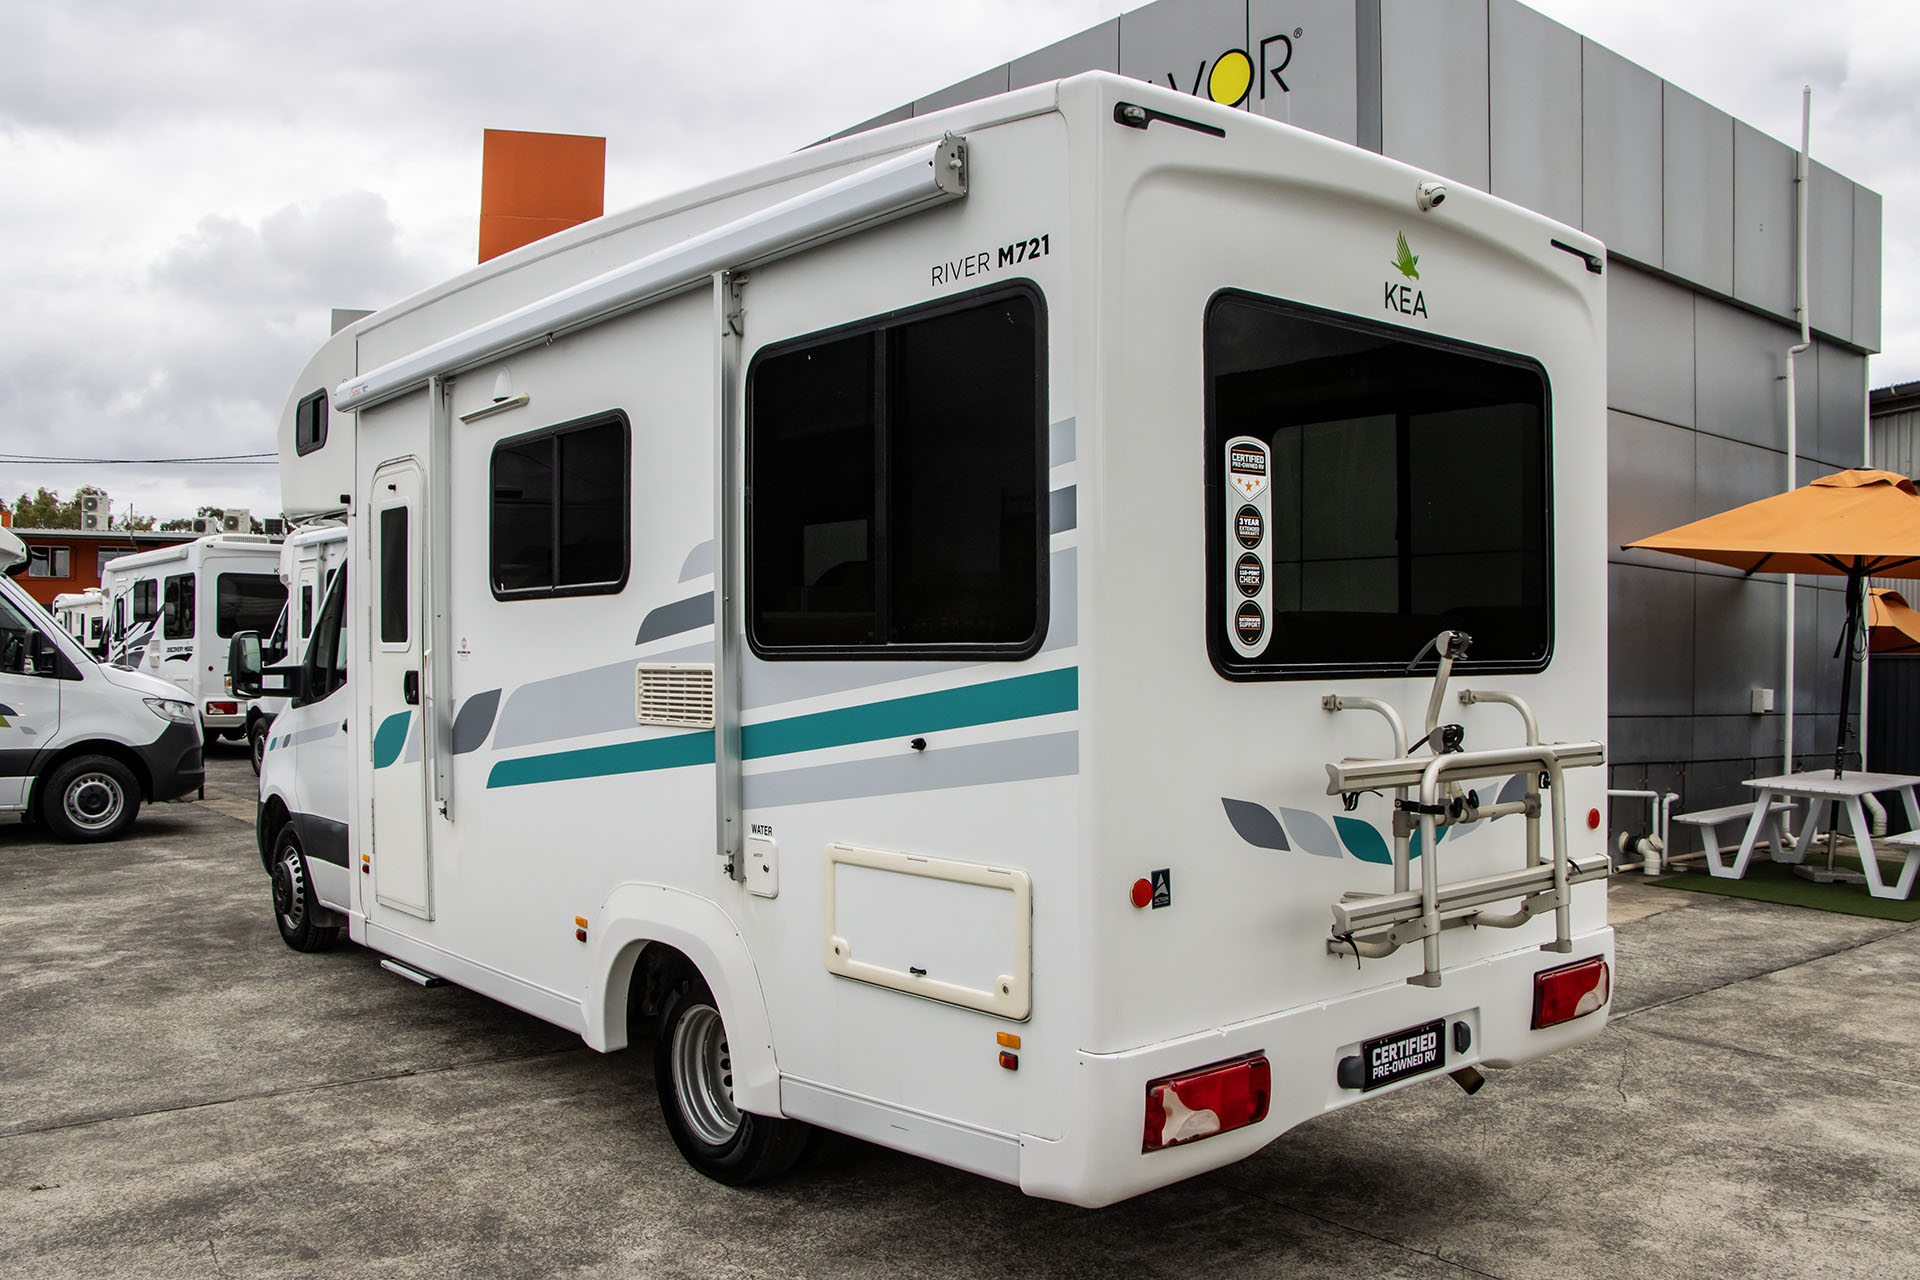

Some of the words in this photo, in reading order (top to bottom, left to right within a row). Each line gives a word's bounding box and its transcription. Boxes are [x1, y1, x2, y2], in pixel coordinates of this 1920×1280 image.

[931, 252, 990, 287] RIVER
[998, 233, 1050, 268] M721
[1384, 281, 1428, 319] KEA
[1232, 453, 1264, 464] CERTIFIED
[1232, 461, 1258, 469] PRE-OWNED
[1239, 517, 1244, 525] 3
[1244, 518, 1260, 526] YEAR
[1239, 575, 1260, 584] CHECK
[751, 823, 773, 837] WATER
[1372, 1031, 1437, 1067] CERTIFIED
[1372, 1053, 1424, 1080] PRE-OWNED
[1424, 1048, 1437, 1063] RV
